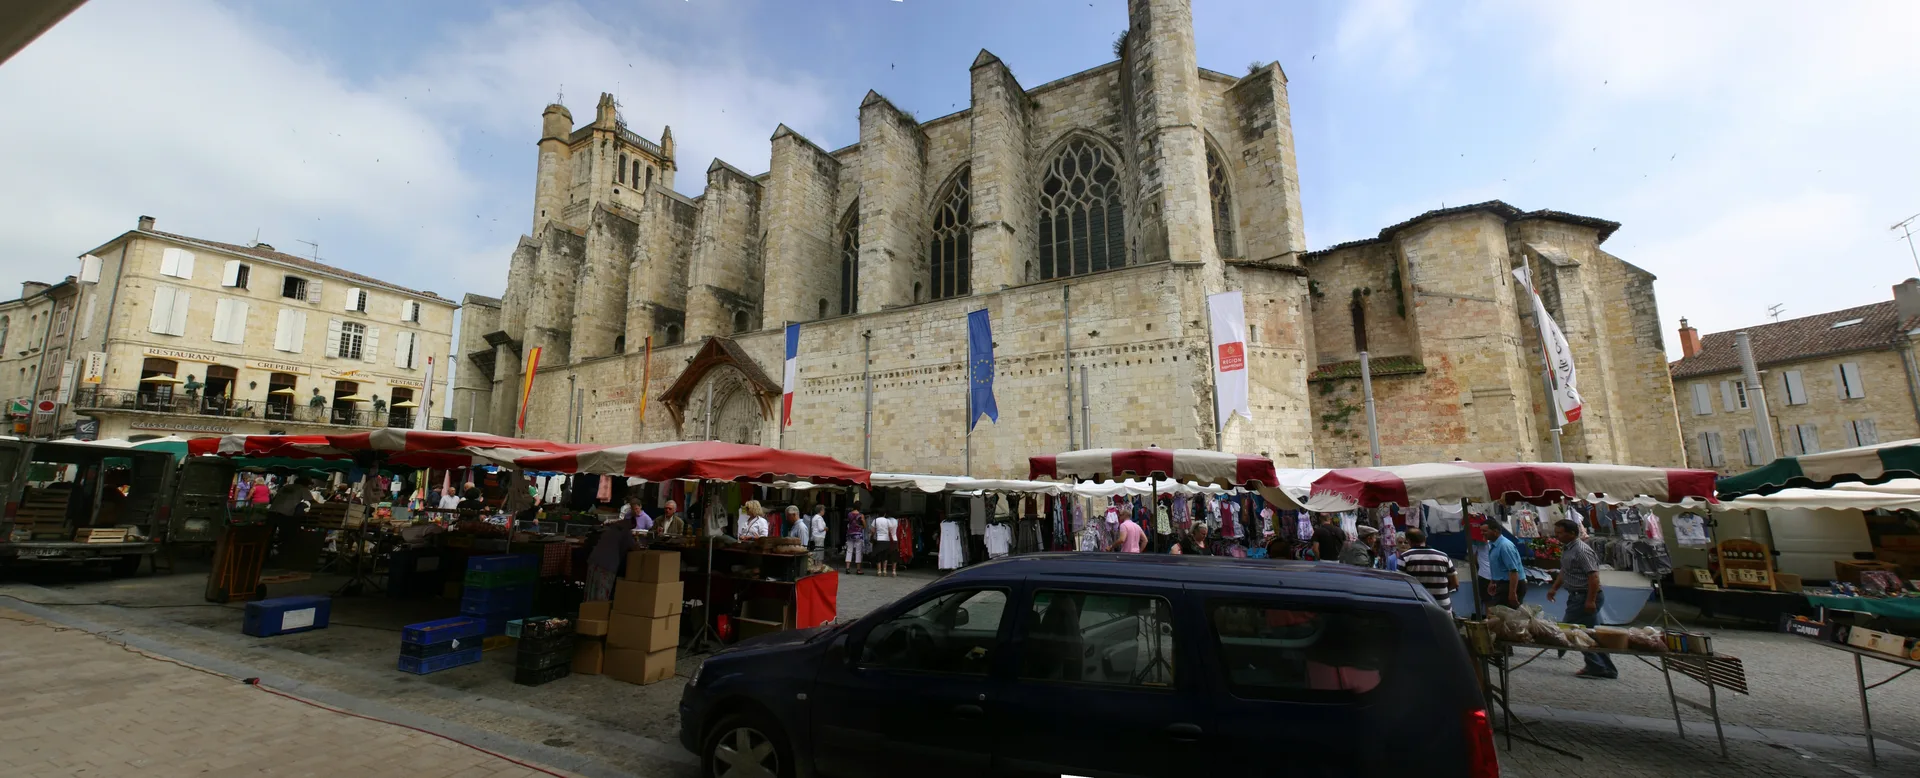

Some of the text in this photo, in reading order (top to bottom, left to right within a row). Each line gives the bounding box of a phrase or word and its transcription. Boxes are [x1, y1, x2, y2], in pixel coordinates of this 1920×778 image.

[148, 347, 218, 362] RESTAURANT
[257, 361, 300, 372] CREPERIE
[390, 378, 424, 387] RESTAURA
[131, 421, 168, 429] CAISSE
